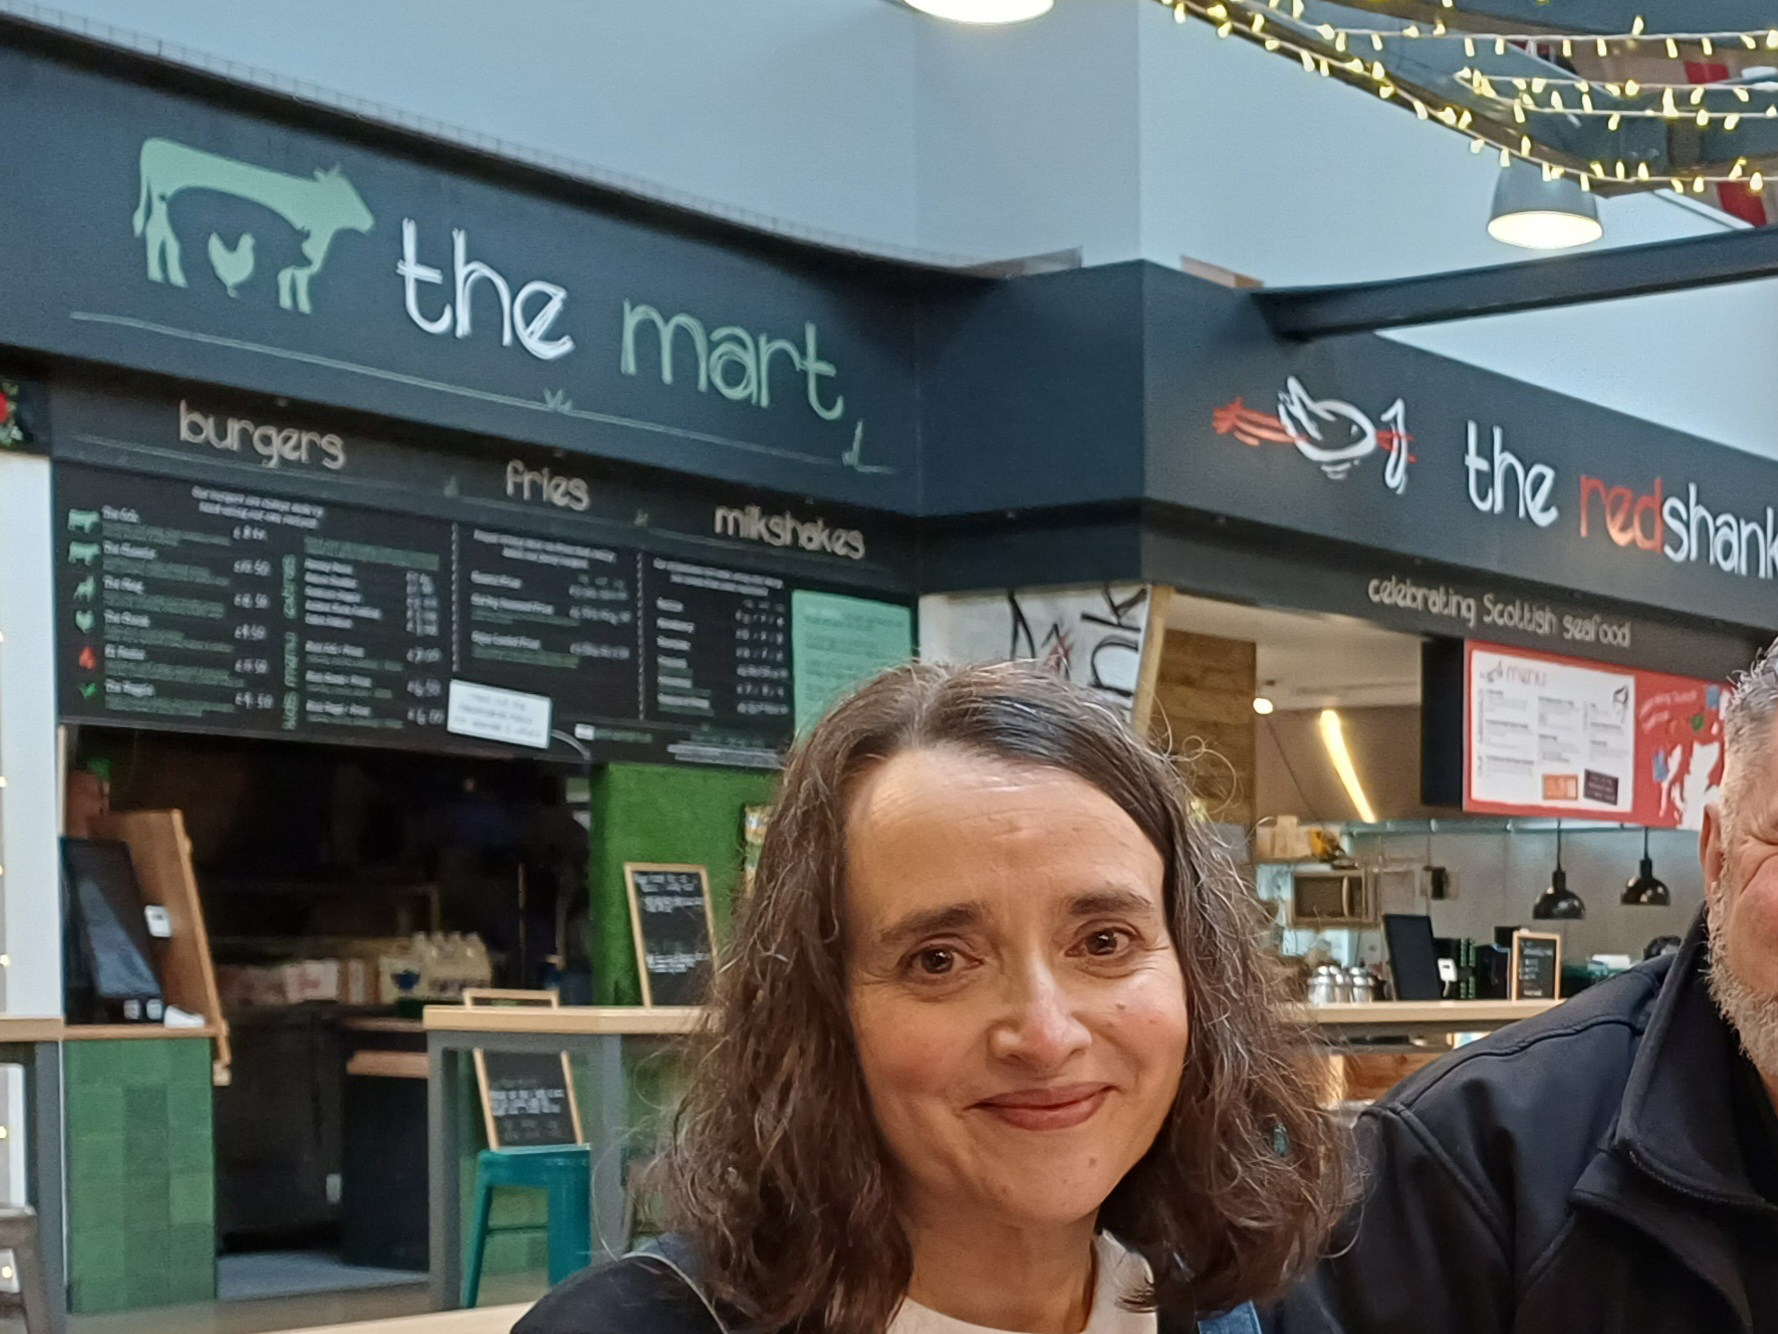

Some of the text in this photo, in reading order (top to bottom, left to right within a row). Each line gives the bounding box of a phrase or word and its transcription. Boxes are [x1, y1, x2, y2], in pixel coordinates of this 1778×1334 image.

[396, 216, 844, 420] the mart
[178, 399, 347, 469] burgers
[505, 459, 591, 512] fries
[1464, 419, 1559, 528] the
[714, 503, 866, 561] milkshakes
[1367, 574, 1632, 648] celebrating Scottish seafood
